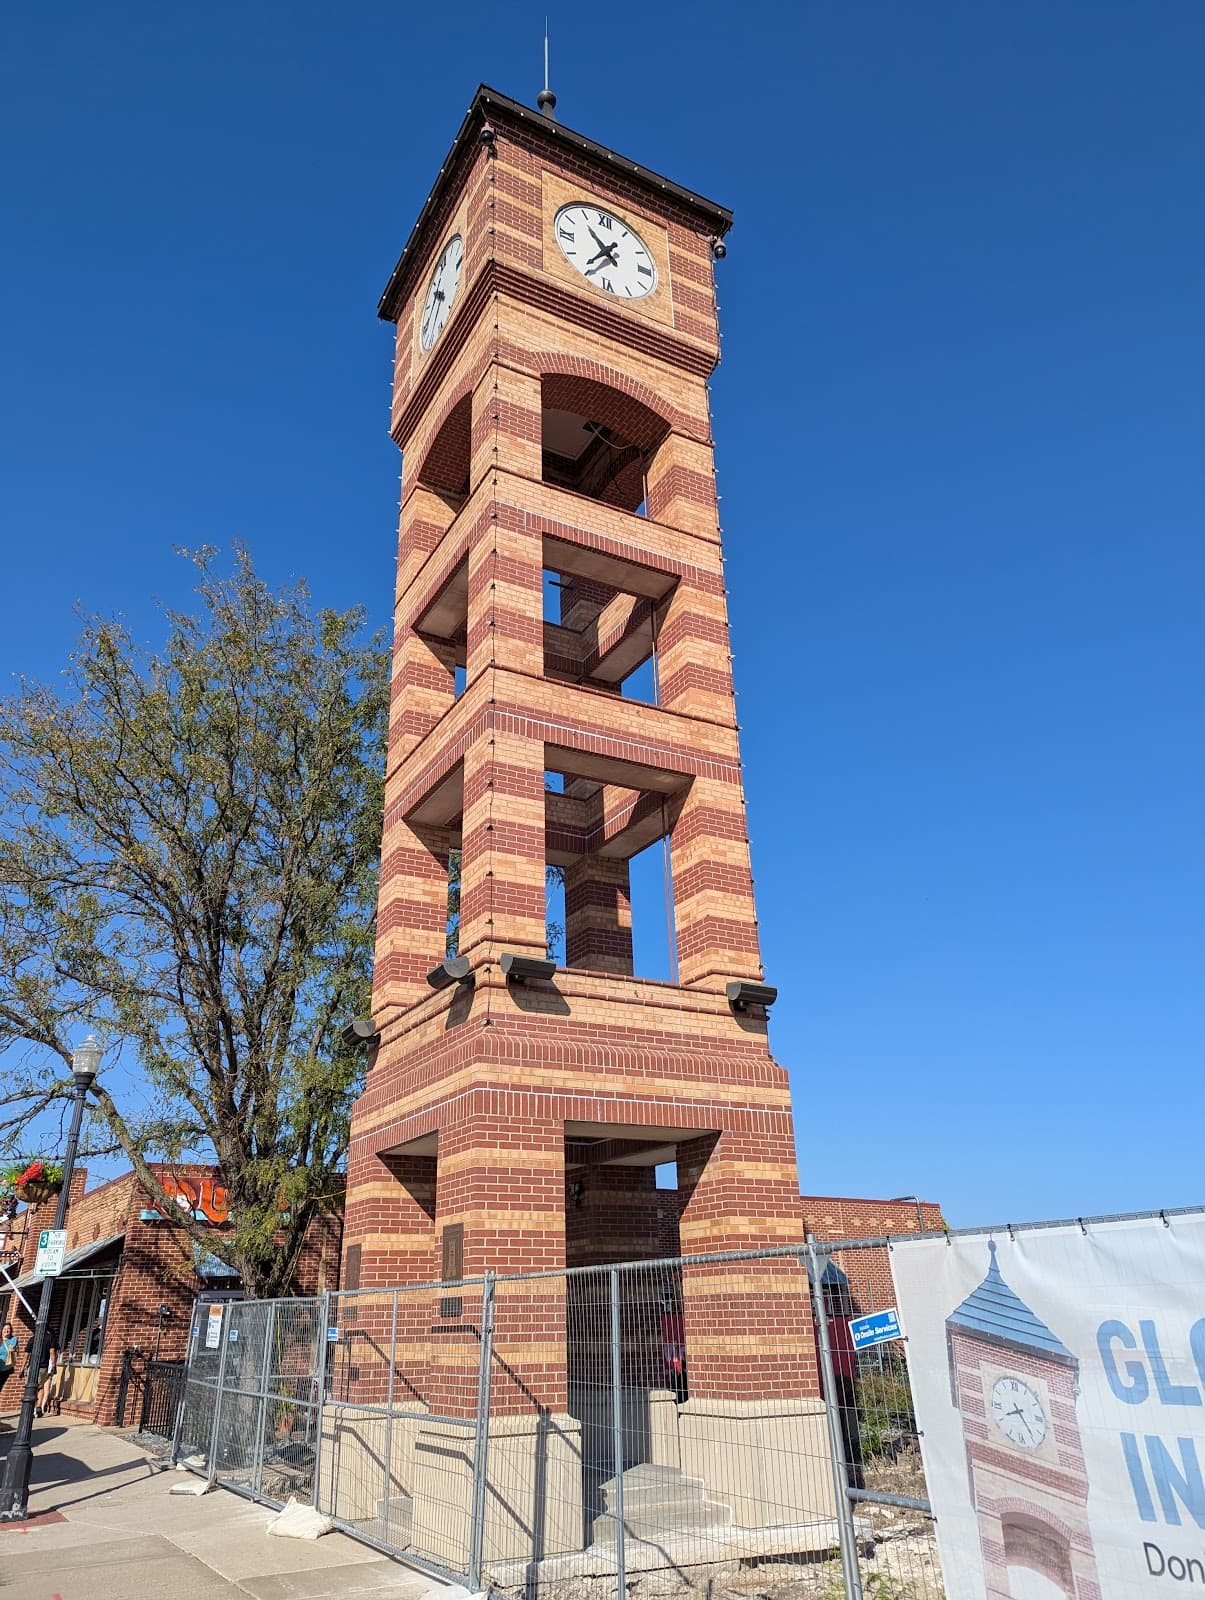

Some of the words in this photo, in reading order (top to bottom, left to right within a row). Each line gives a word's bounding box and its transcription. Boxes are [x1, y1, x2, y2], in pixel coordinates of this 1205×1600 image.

[598, 213, 613, 231] XII
[559, 227, 575, 243] IX
[41, 1234, 48, 1247] 3
